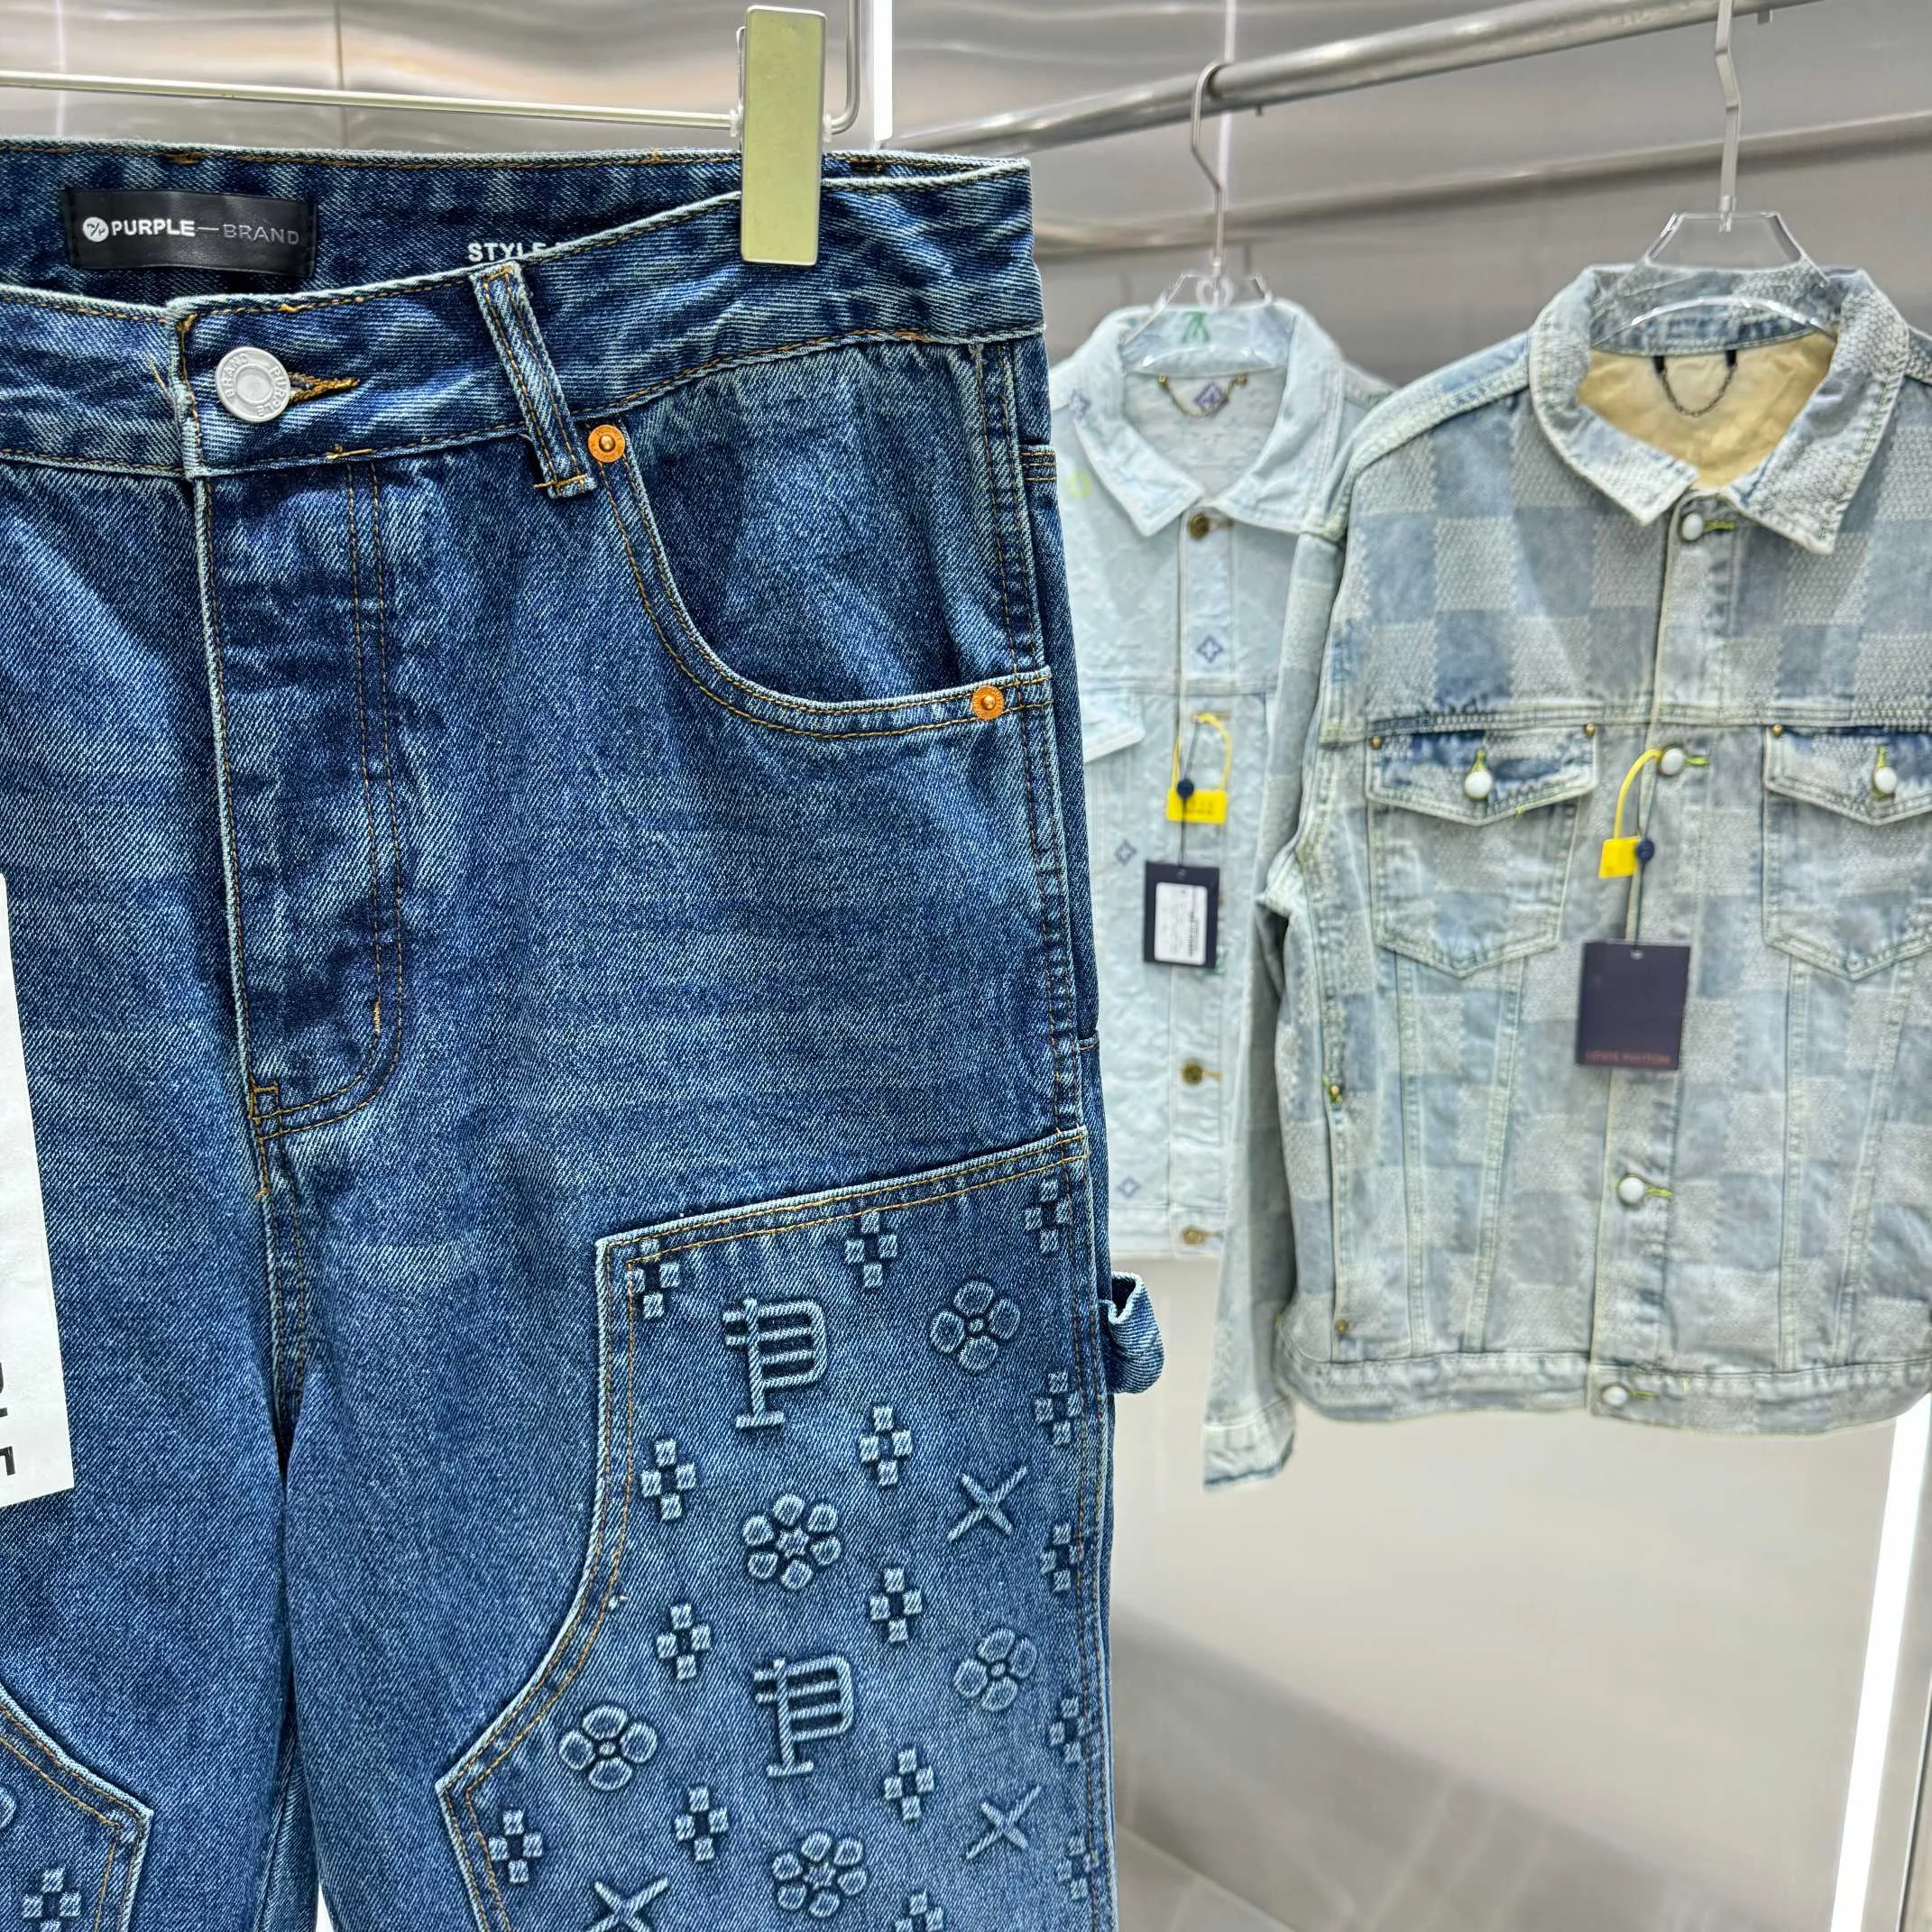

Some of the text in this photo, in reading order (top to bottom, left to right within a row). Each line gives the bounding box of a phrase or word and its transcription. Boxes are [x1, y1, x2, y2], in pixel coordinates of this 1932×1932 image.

[111, 217, 299, 245] PURPLE BRAND
[223, 353, 287, 417] PURPLE BRAND
